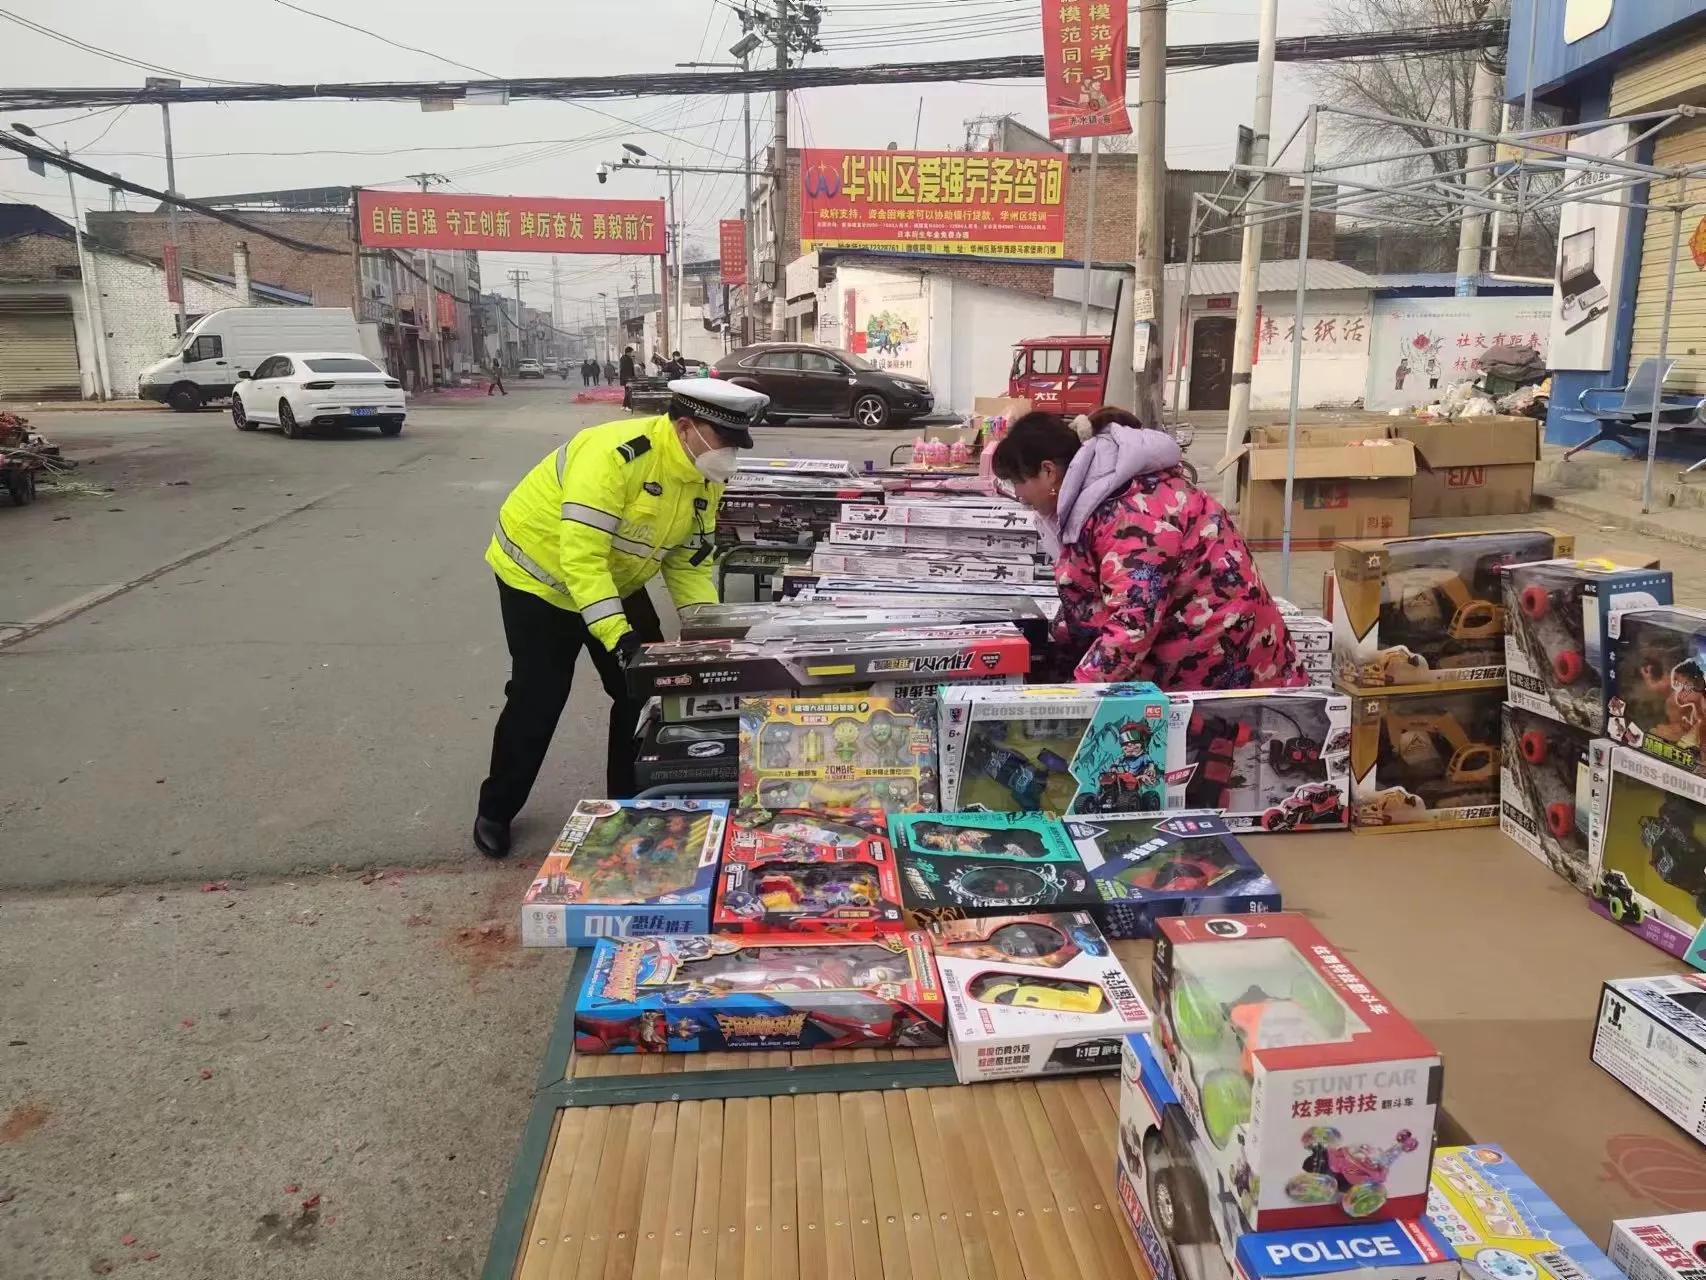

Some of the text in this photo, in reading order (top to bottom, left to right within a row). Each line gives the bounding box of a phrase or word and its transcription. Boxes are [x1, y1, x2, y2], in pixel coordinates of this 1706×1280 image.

[1059, 0, 1083, 83] 模范同行
[841, 155, 1063, 205] 华州区爱强劳务咨询
[371, 207, 655, 241] 自信自强 守正创新 踔厉奋发 勇毅前行
[584, 916, 633, 937] DIY
[1291, 1069, 1417, 1097] STUNT CAR
[1291, 1094, 1378, 1119] 炫舞特技
[1266, 1236, 1400, 1266] POLICE
